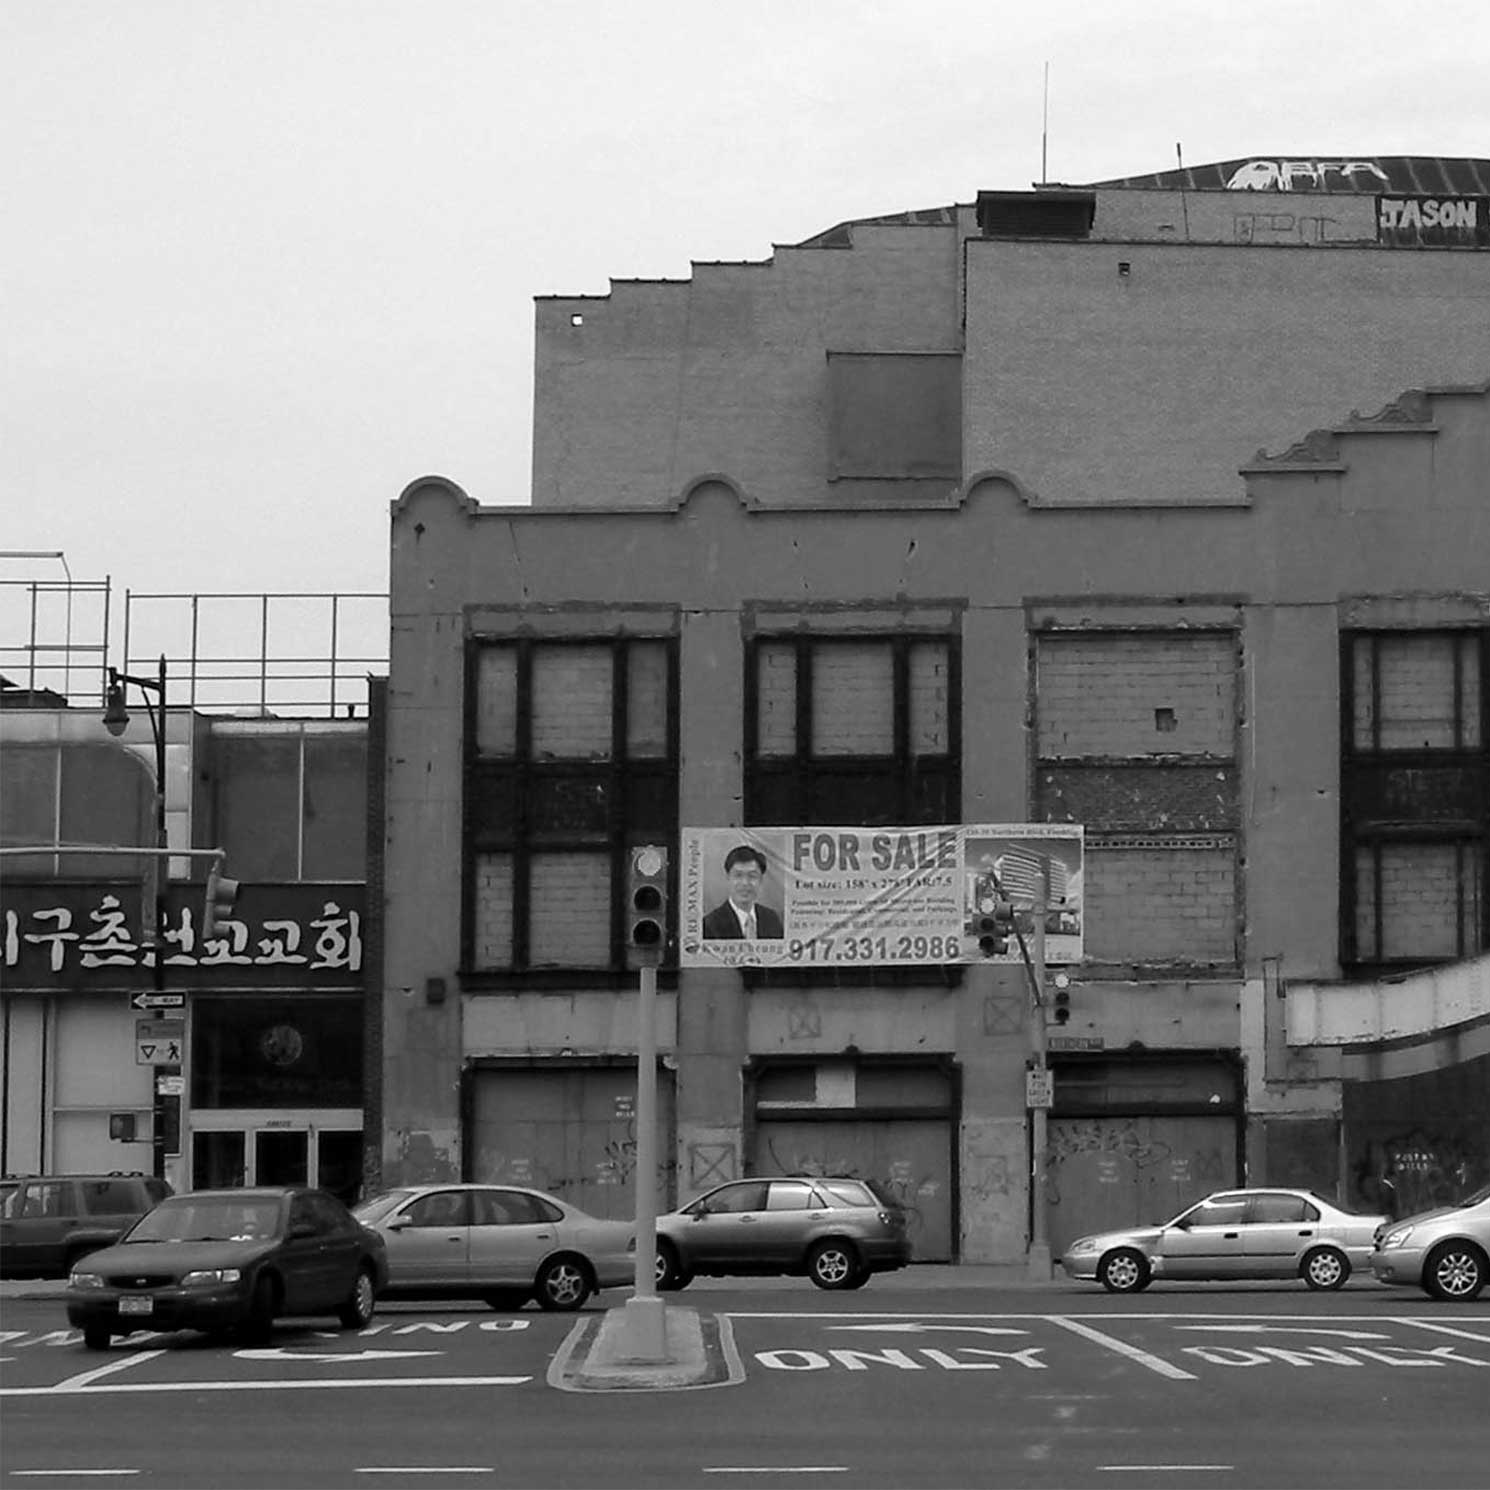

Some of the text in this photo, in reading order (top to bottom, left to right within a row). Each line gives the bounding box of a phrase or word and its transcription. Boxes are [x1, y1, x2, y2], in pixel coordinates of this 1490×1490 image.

[1380, 200, 1477, 228] JASON
[793, 832, 957, 871] FOR SALE
[795, 879, 815, 889] Lot
[789, 936, 960, 961] 917.331.2986
[754, 1348, 1048, 1370] ONLY
